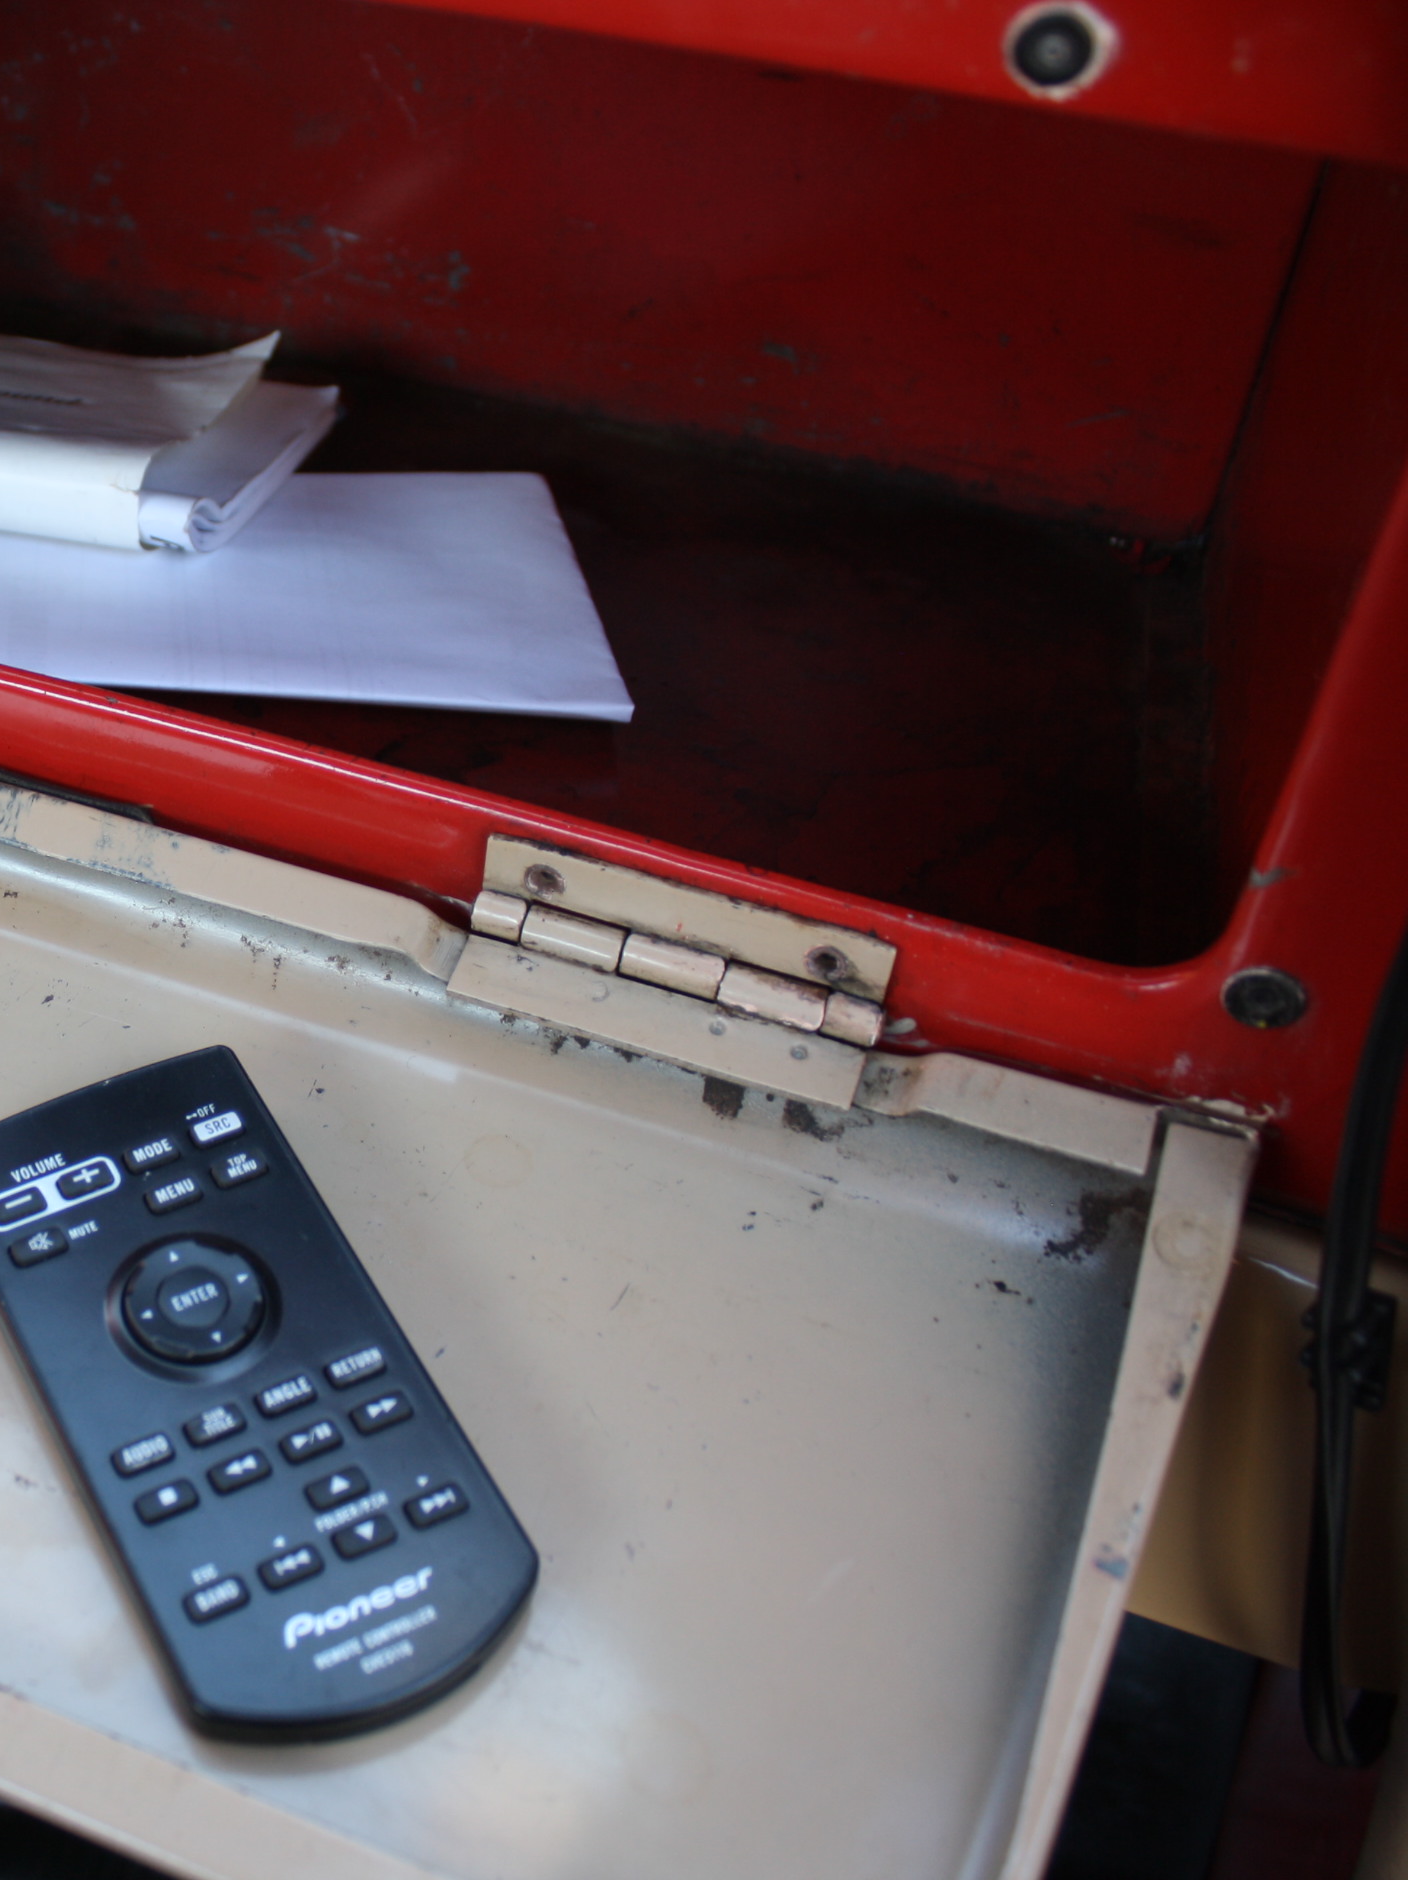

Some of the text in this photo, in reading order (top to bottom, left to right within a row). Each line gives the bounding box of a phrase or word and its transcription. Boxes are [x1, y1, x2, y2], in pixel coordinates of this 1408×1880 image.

[197, 1103, 216, 1118] OFF
[204, 1116, 231, 1135] SRC
[132, 1138, 173, 1163] MODE
[226, 1153, 247, 1167] TOP
[10, 1153, 66, 1184] VOLUME
[227, 1160, 257, 1178] MENU
[154, 1178, 195, 1203] MENU
[68, 1220, 99, 1240] MUTE
[171, 1282, 218, 1312] ENTER
[330, 1346, 382, 1379] RETURN
[263, 1375, 312, 1408] ANGLE
[121, 1434, 169, 1467] AUDIO
[283, 1565, 433, 1650] Pioneer
